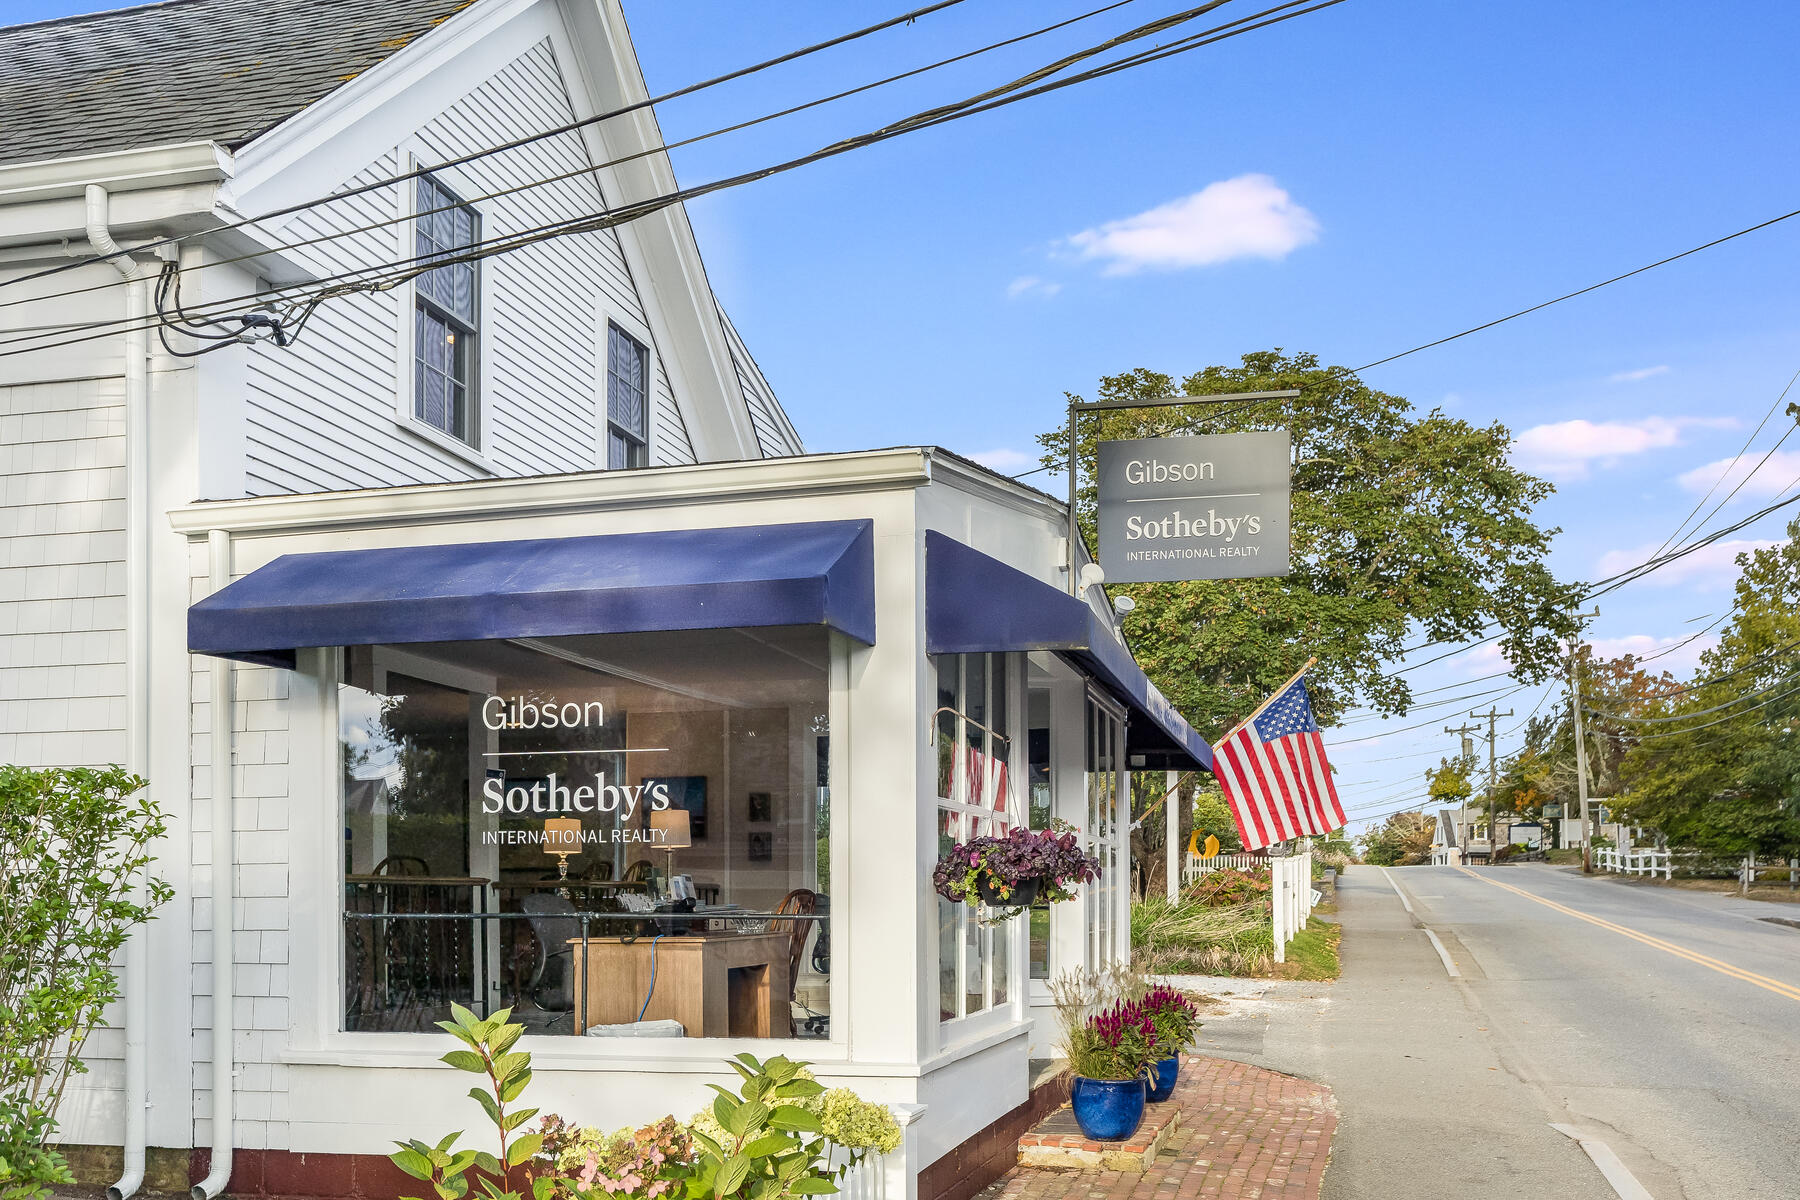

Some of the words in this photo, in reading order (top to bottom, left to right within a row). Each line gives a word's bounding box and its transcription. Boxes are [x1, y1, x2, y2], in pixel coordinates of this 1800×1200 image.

[1125, 460, 1214, 485] Gibson
[1126, 509, 1261, 542] Sotheby's
[1127, 548, 1216, 561] INTERNATIONAL
[1219, 546, 1260, 557] REALTY
[482, 695, 604, 731] Gibson
[482, 771, 670, 821] Sotheby's
[482, 830, 607, 845] INTERNATIONAL
[611, 828, 669, 843] REALTY
